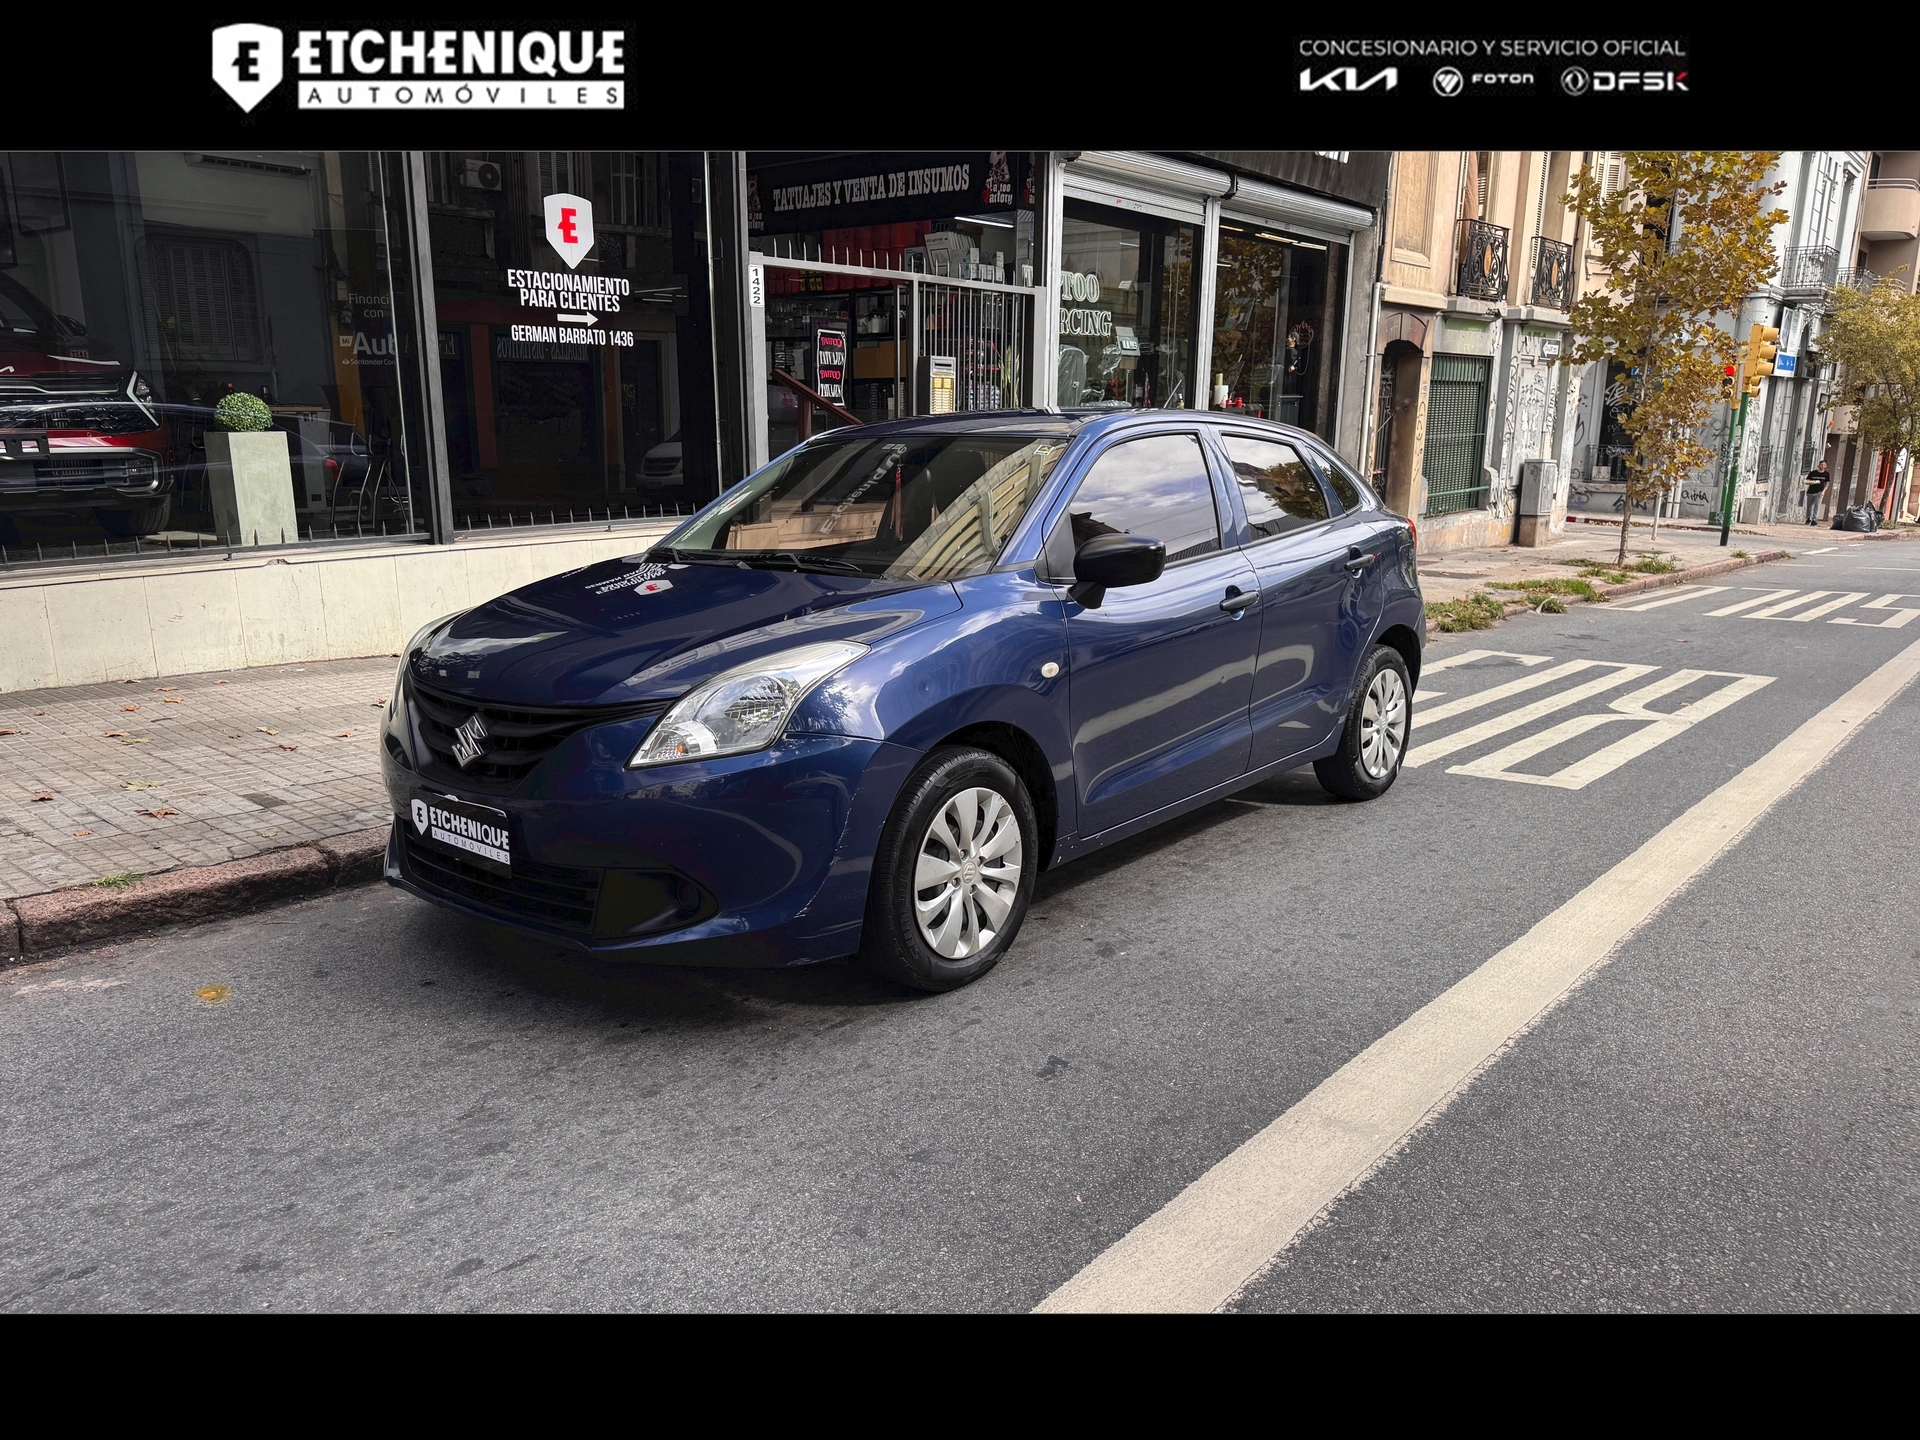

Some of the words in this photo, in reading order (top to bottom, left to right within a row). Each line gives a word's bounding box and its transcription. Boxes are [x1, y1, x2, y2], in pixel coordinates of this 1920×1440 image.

[773, 182, 831, 212] TATUAJES
[833, 180, 841, 204] Y
[843, 174, 886, 203] VENTA
[888, 171, 906, 198] DE
[907, 164, 970, 195] INSUMOS
[507, 268, 630, 296] ESTACIONAMIENTO
[752, 268, 761, 305] 1422
[348, 293, 390, 305] Financi
[520, 288, 557, 309] PARA
[559, 291, 620, 312] CLIENTES
[363, 308, 384, 318] con
[352, 331, 397, 355] Aut
[511, 324, 557, 343] GERMAN
[559, 327, 606, 346] BARBATO
[609, 330, 634, 347] 1436
[350, 358, 383, 366] Santander
[429, 806, 510, 851] ETCHENIQUE
[433, 829, 509, 863] AUTOMÓVILES
